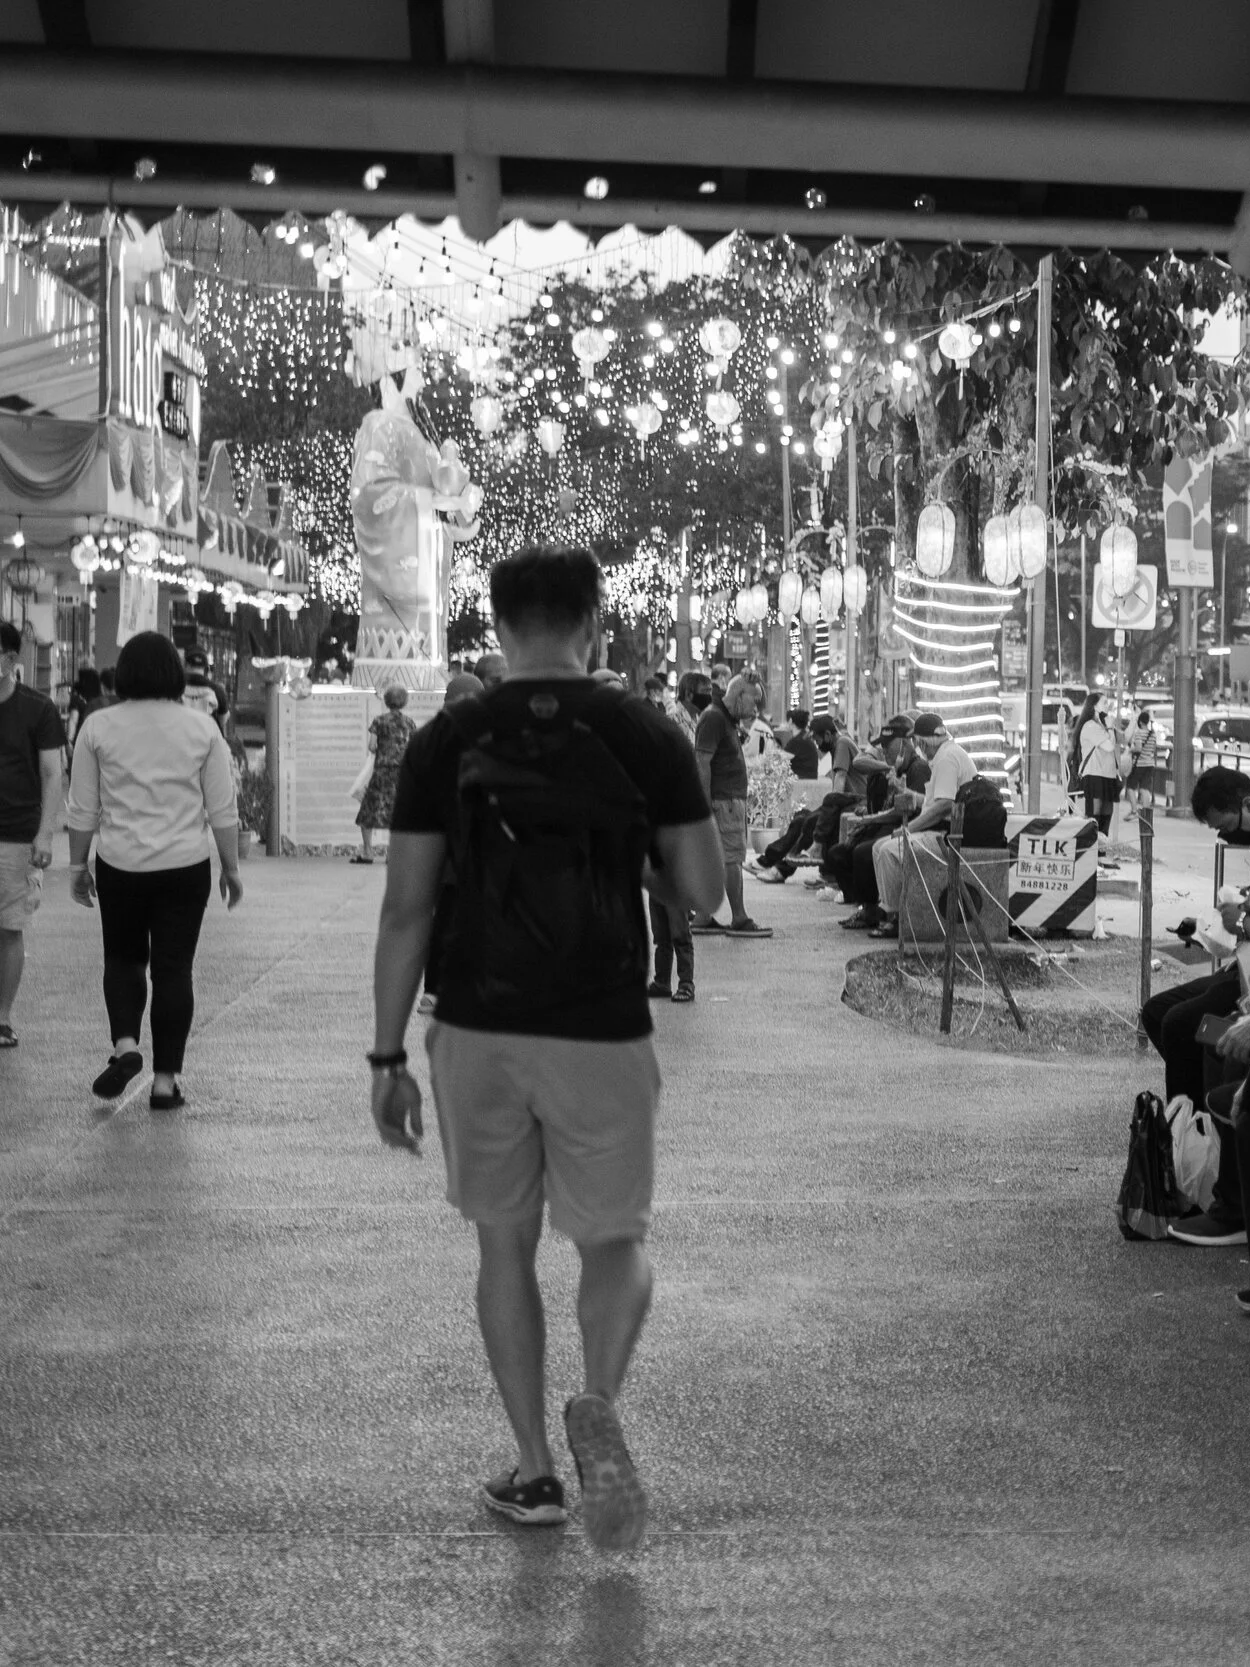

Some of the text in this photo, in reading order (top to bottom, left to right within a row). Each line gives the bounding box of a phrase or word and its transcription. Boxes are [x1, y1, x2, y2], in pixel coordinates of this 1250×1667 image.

[1027, 837, 1068, 857] TLK
[1020, 861, 1071, 877] 新年快乐
[1020, 880, 1068, 891] 84881228
